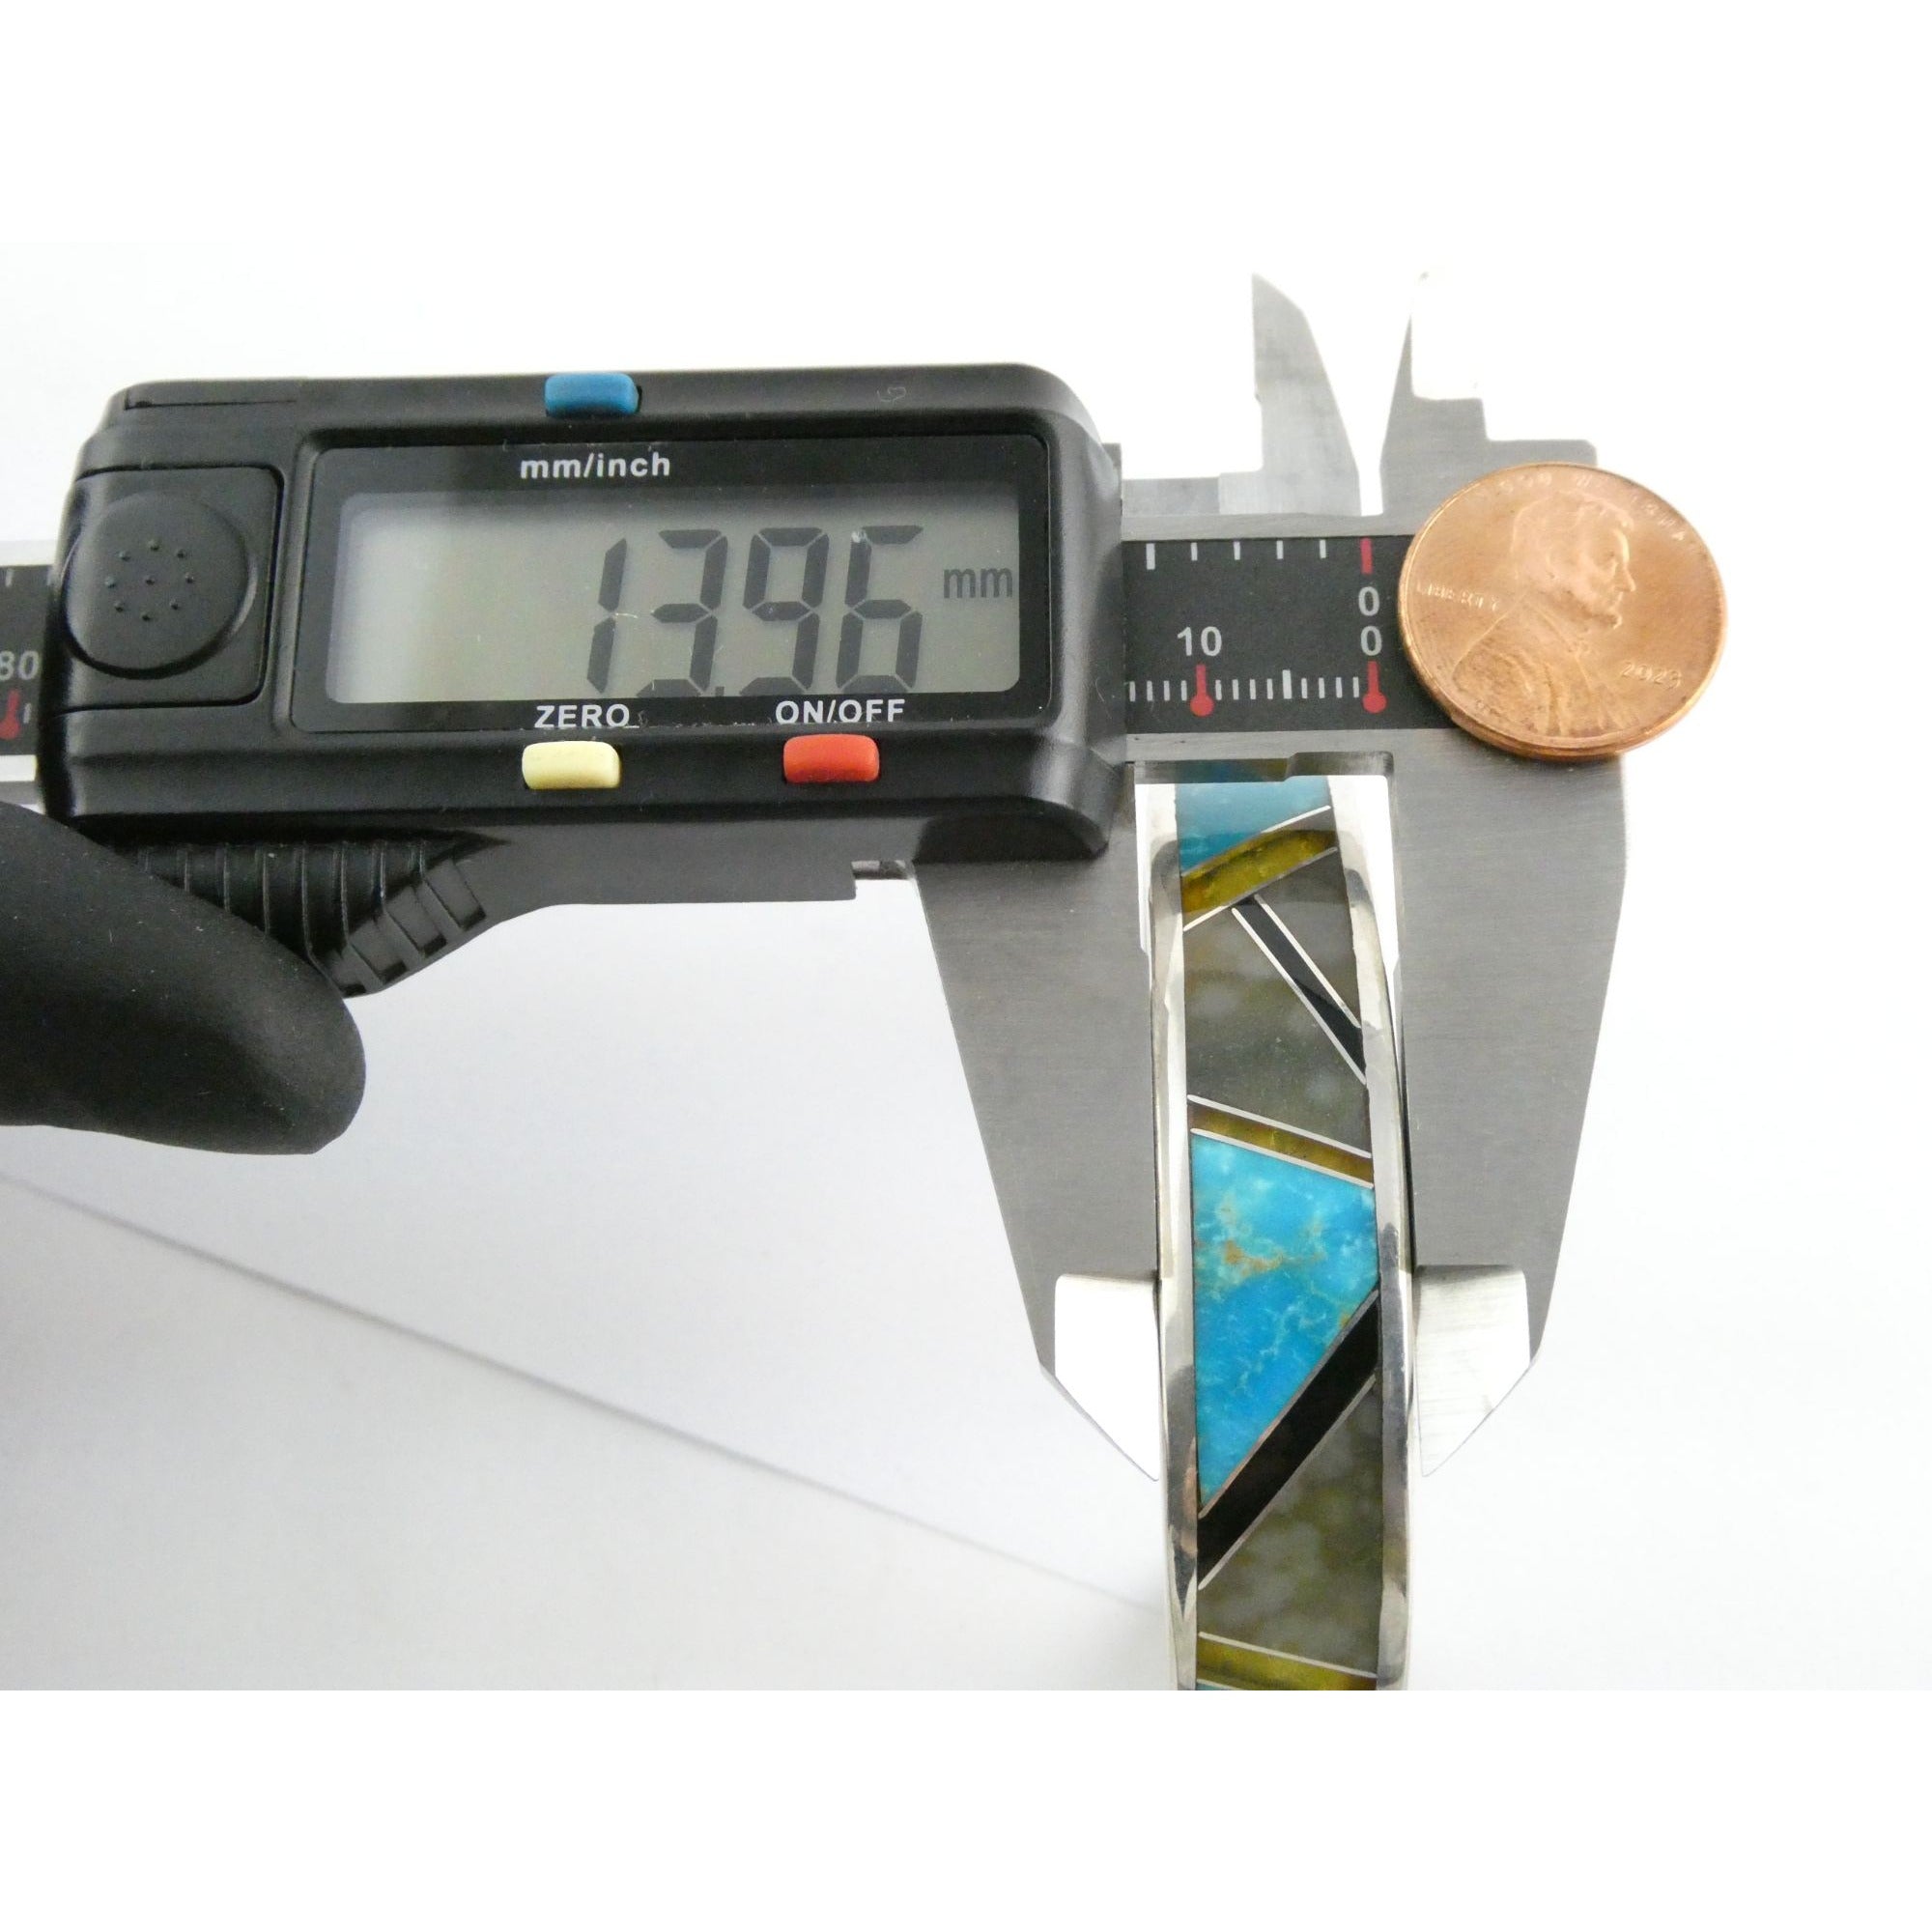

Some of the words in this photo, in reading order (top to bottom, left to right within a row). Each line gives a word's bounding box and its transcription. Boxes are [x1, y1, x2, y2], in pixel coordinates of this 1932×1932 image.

[520, 452, 671, 480] mm/inch
[943, 567, 1014, 600] mm
[1357, 585, 1380, 617] 0
[1177, 625, 1223, 657] 10
[1359, 625, 1383, 657] 0
[0, 649, 41, 681] 80
[533, 703, 631, 729] ZERO
[774, 698, 906, 725] ON/OFF
